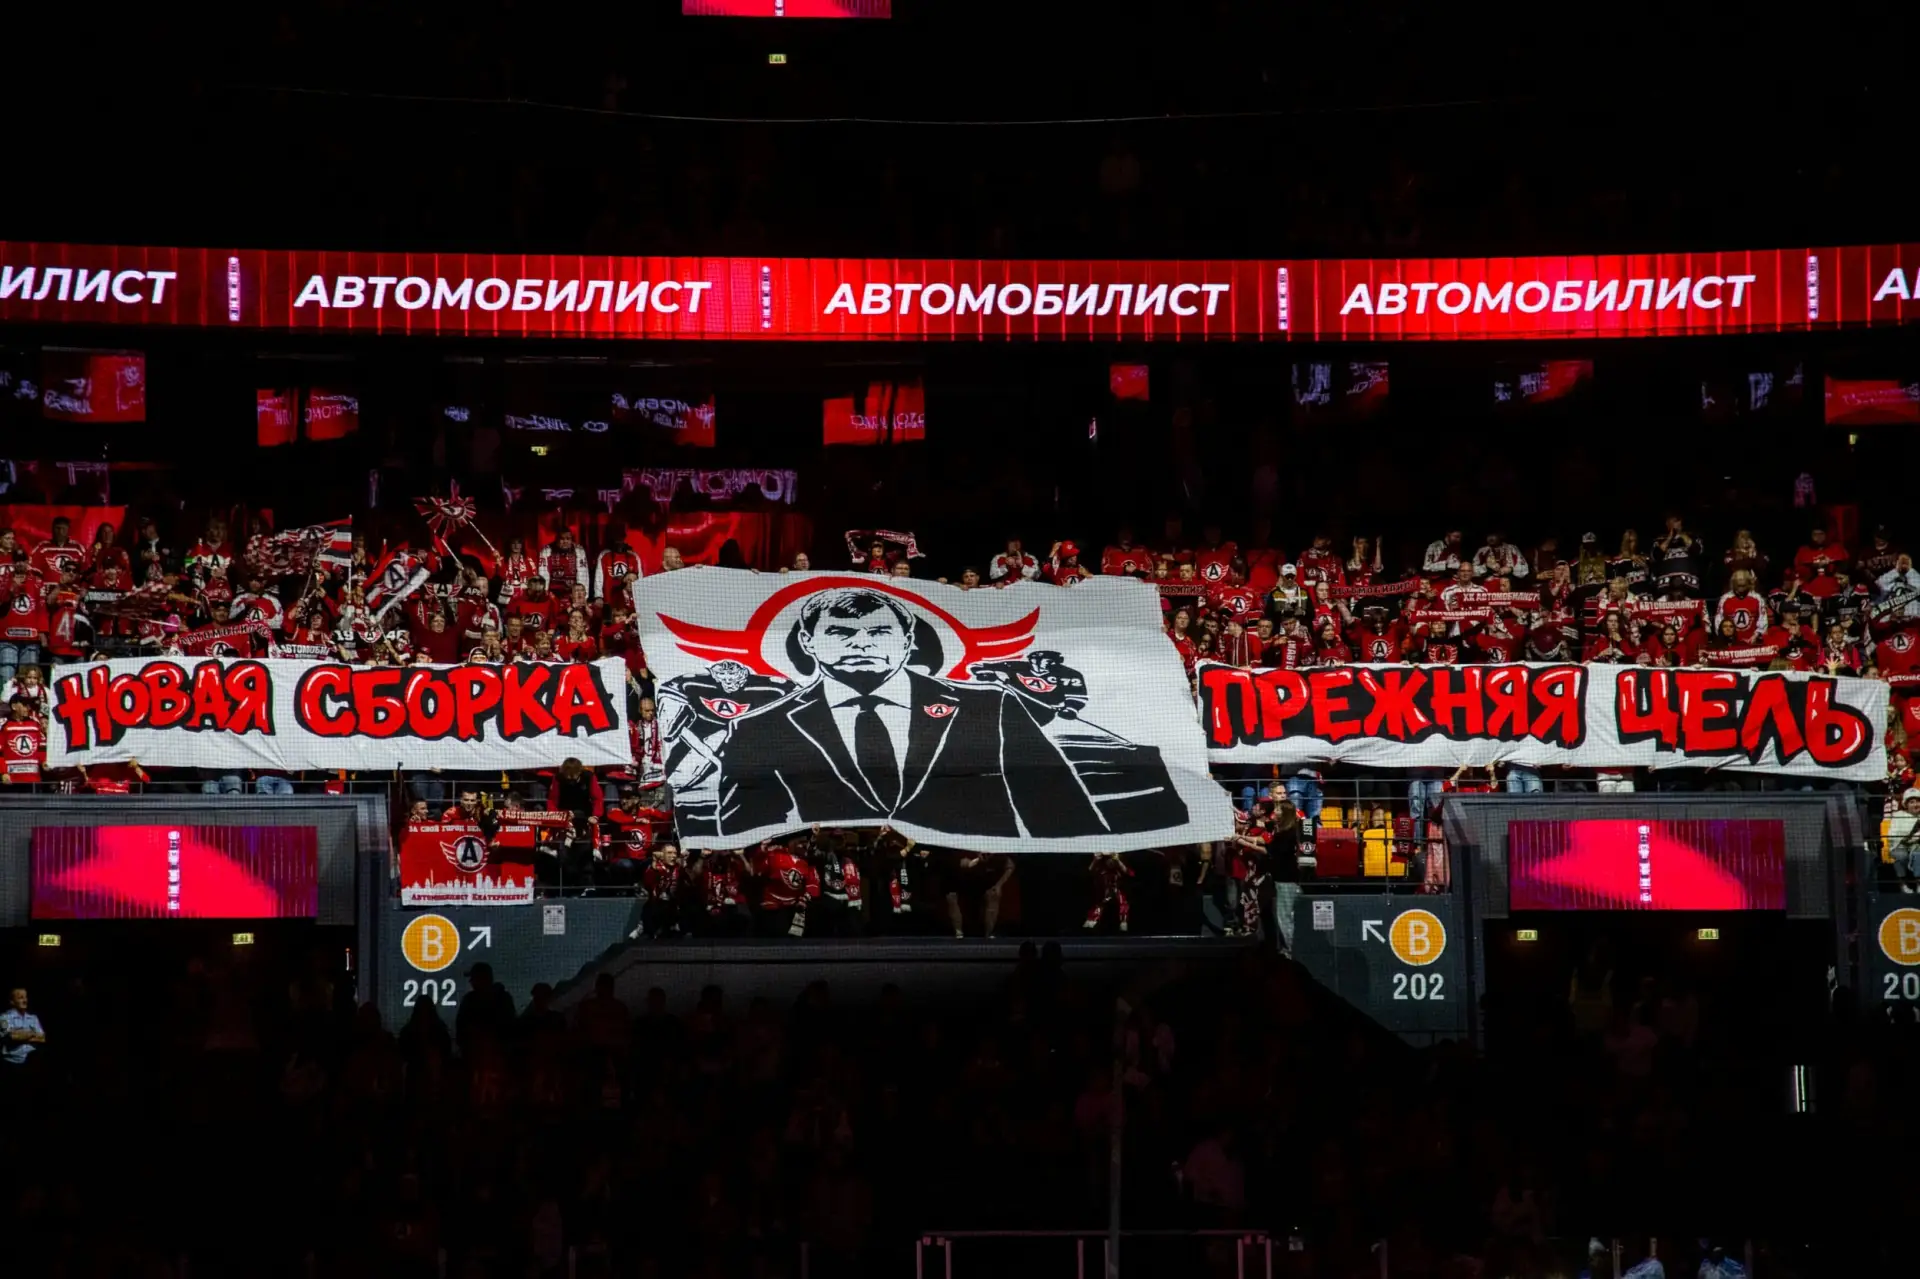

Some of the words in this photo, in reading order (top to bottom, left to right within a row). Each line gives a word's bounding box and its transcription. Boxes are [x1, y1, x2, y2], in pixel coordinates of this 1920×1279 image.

[0, 266, 177, 304] ИЛИСТ
[294, 275, 713, 313] АВТОМОБИЛИСТ
[824, 283, 1230, 316] АВТОМОБИЛИСТ
[1340, 274, 1756, 315] АВТОМОБИЛИСТ
[1060, 677, 1083, 687] 72
[53, 660, 276, 753] НОВАЯ
[294, 663, 619, 742] СБОРКА
[1201, 666, 1588, 749] ПРЕЖНЯЯ
[1616, 668, 1874, 766] ЦЕЛЬ
[421, 925, 444, 961] B
[1409, 920, 1430, 956] B
[403, 979, 457, 1007] 202
[1393, 973, 1445, 1000] 202
[1884, 973, 1920, 1000] 20
